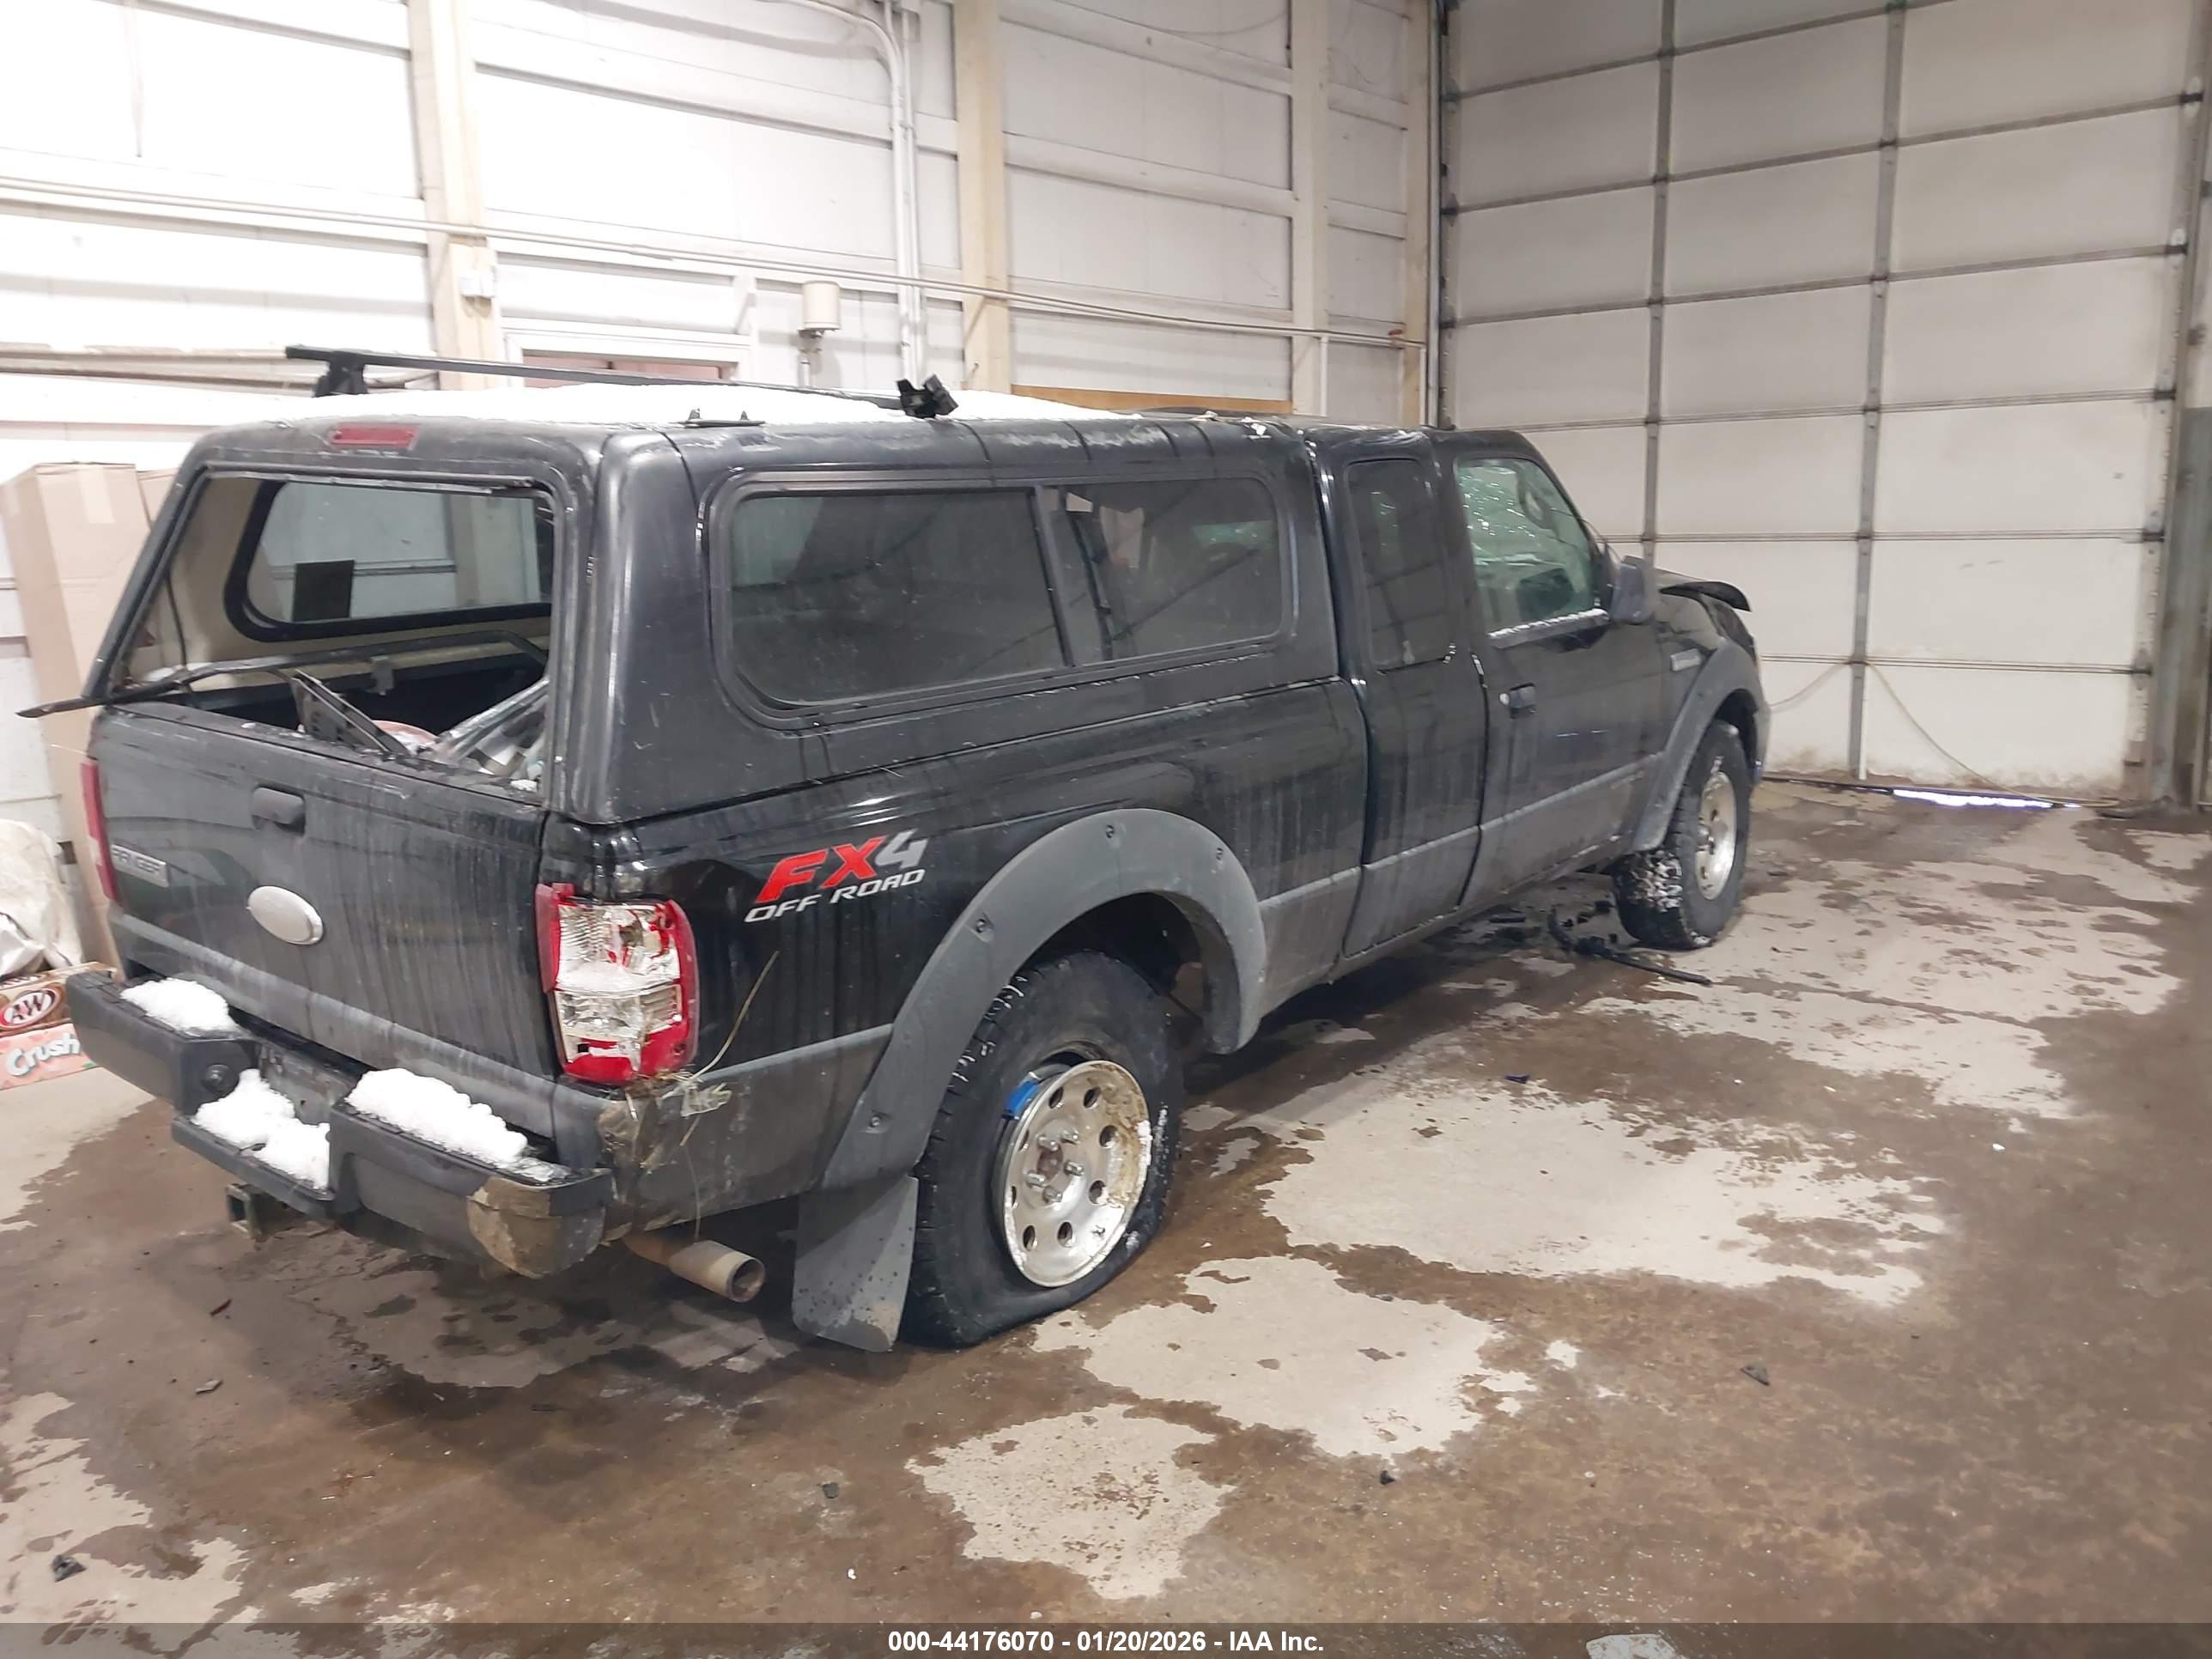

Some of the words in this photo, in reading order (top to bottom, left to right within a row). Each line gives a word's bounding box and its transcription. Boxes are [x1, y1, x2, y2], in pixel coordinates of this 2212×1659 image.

[755, 828, 929, 904] FX4
[744, 894, 823, 923] OFF
[830, 868, 926, 904] ROAD
[6, 1032, 82, 1077] Crush
